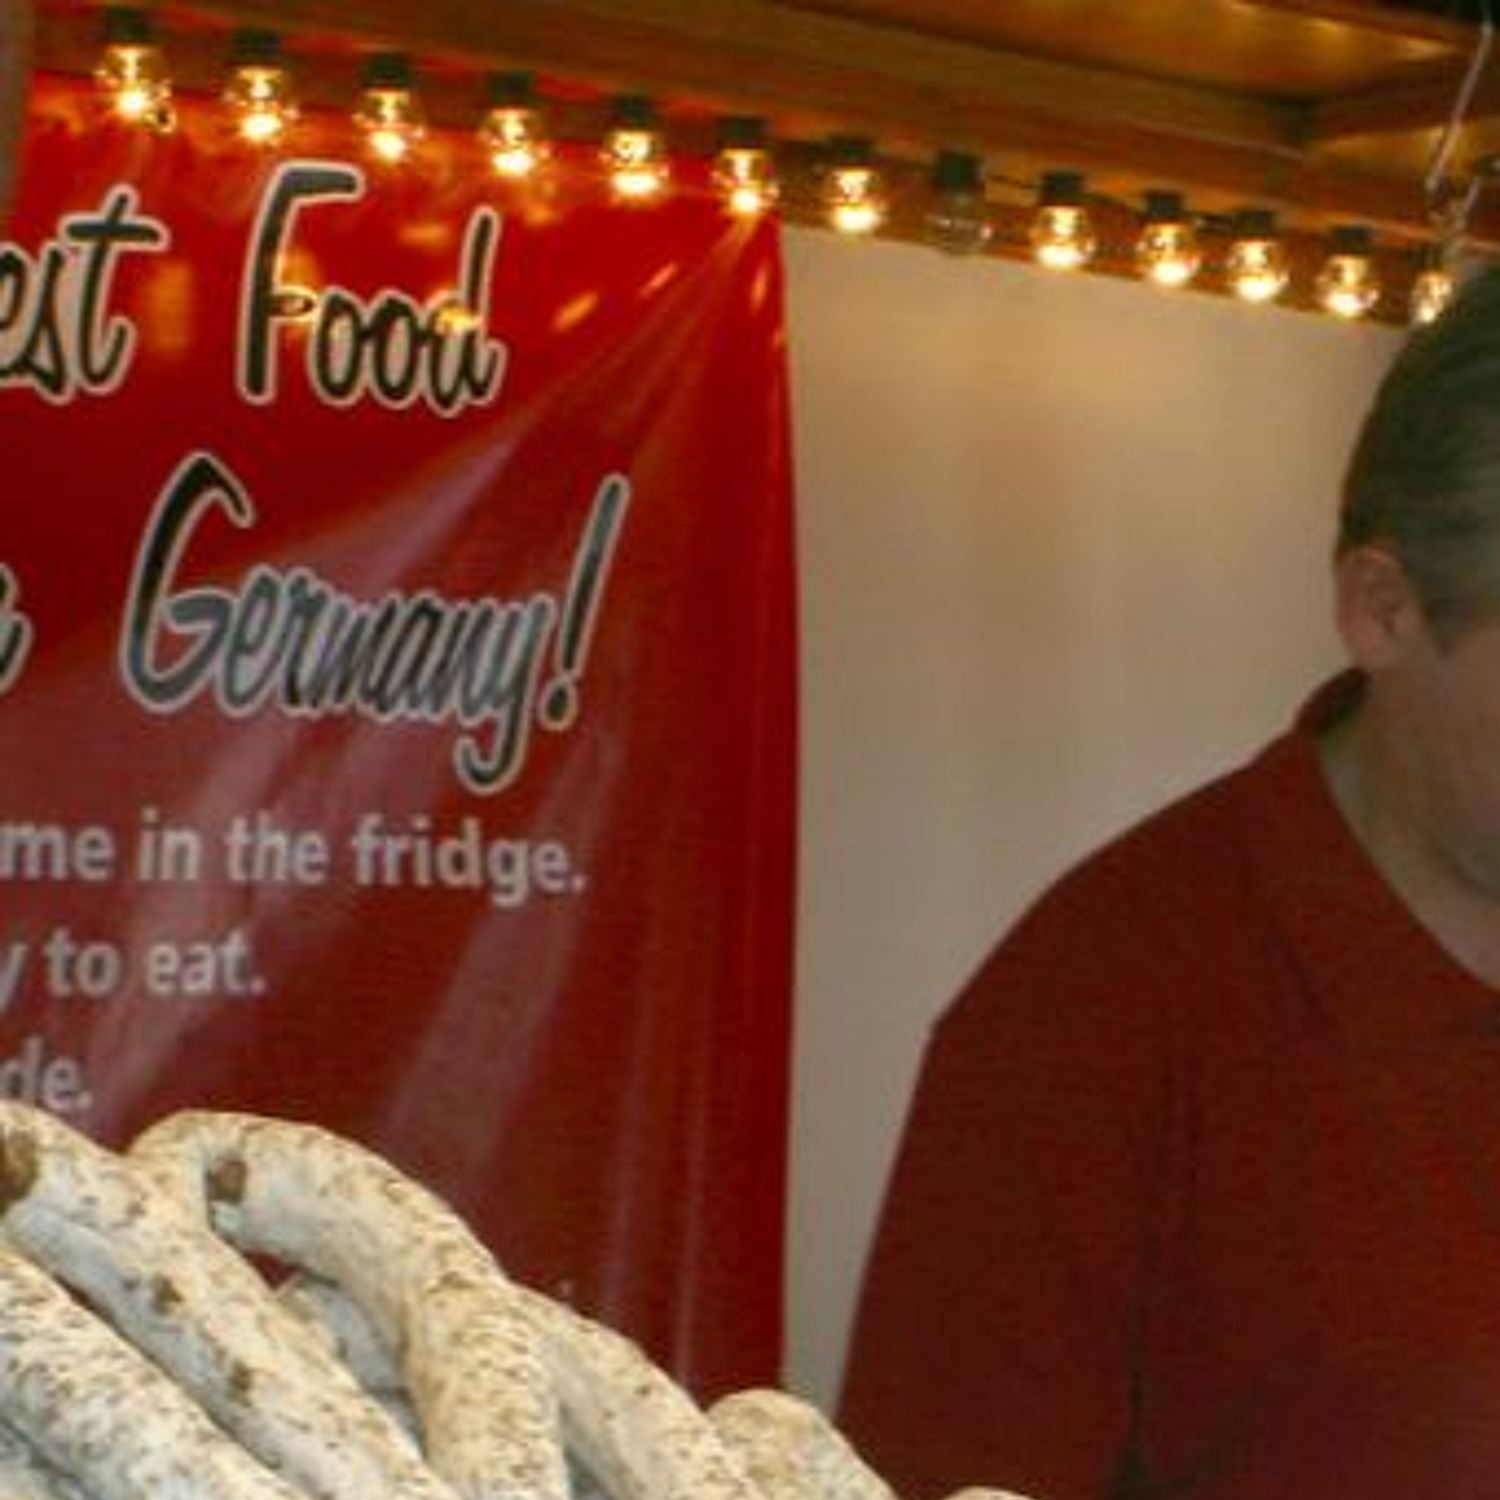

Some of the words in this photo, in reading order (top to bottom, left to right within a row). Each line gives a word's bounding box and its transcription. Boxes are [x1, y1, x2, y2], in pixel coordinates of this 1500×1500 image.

[241, 161, 505, 417] Food
[120, 451, 630, 794] Germany!
[138, 808, 198, 880] in
[225, 811, 330, 883] the
[352, 812, 588, 904] fridge.
[43, 926, 120, 997] to
[146, 928, 267, 995] eat.
